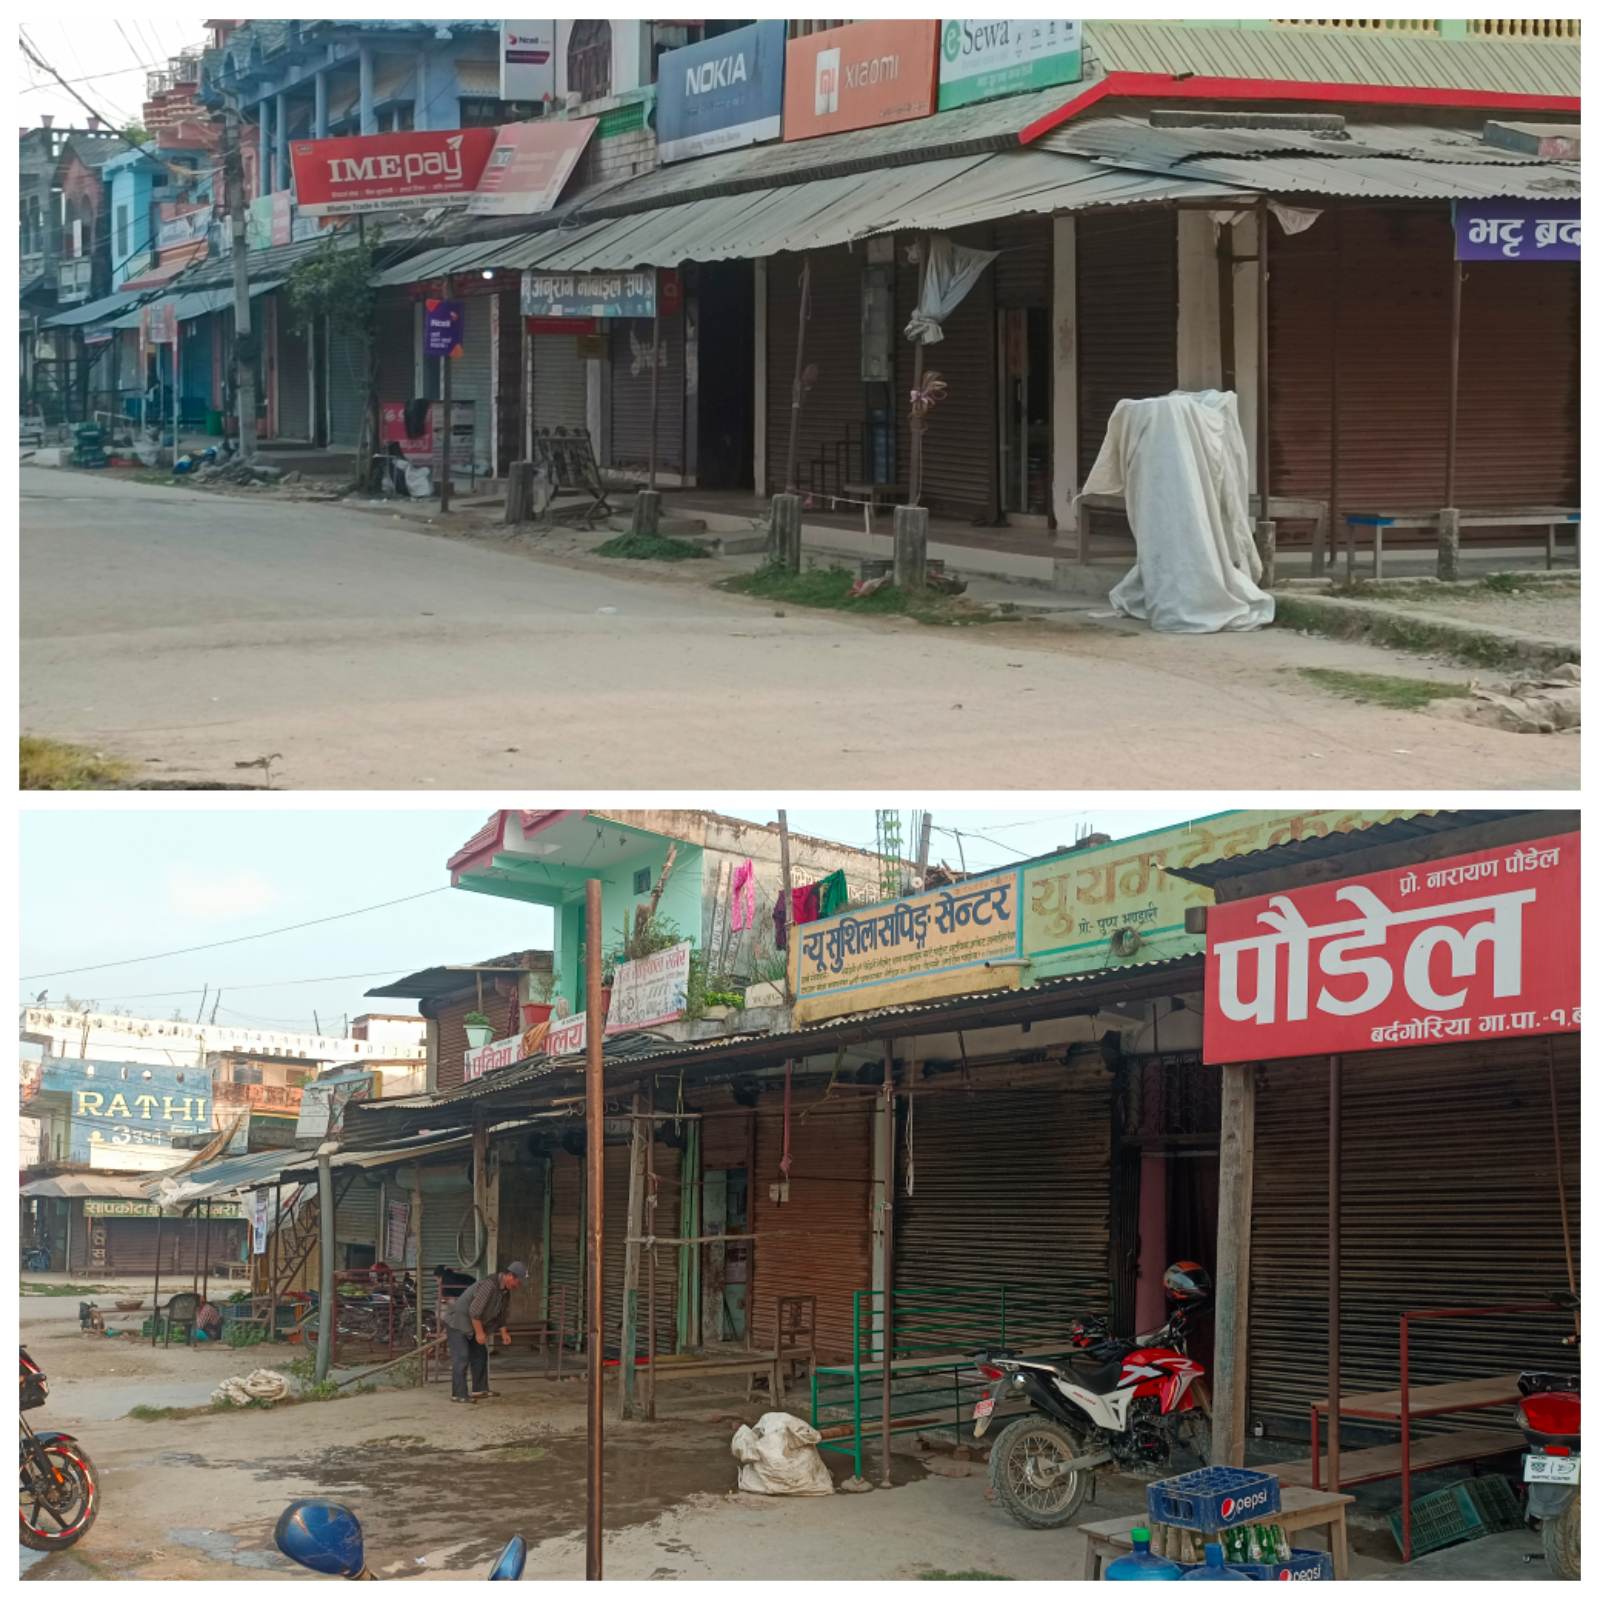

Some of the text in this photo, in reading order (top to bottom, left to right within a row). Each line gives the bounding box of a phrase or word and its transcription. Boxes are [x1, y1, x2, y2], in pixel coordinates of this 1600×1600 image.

[685, 53, 747, 97] NOKIA
[1399, 846, 1561, 897] प्रो. नारायण पौडेल
[802, 930, 827, 973] न्यू
[935, 884, 1011, 935] सेन्टर
[1213, 885, 1537, 1025] पौडेल
[1371, 1015, 1472, 1043] बर्दगोरिया
[76, 1090, 208, 1122] RATHI
[1235, 1488, 1268, 1512] pepsi
[1293, 1563, 1321, 1580] pepsi
